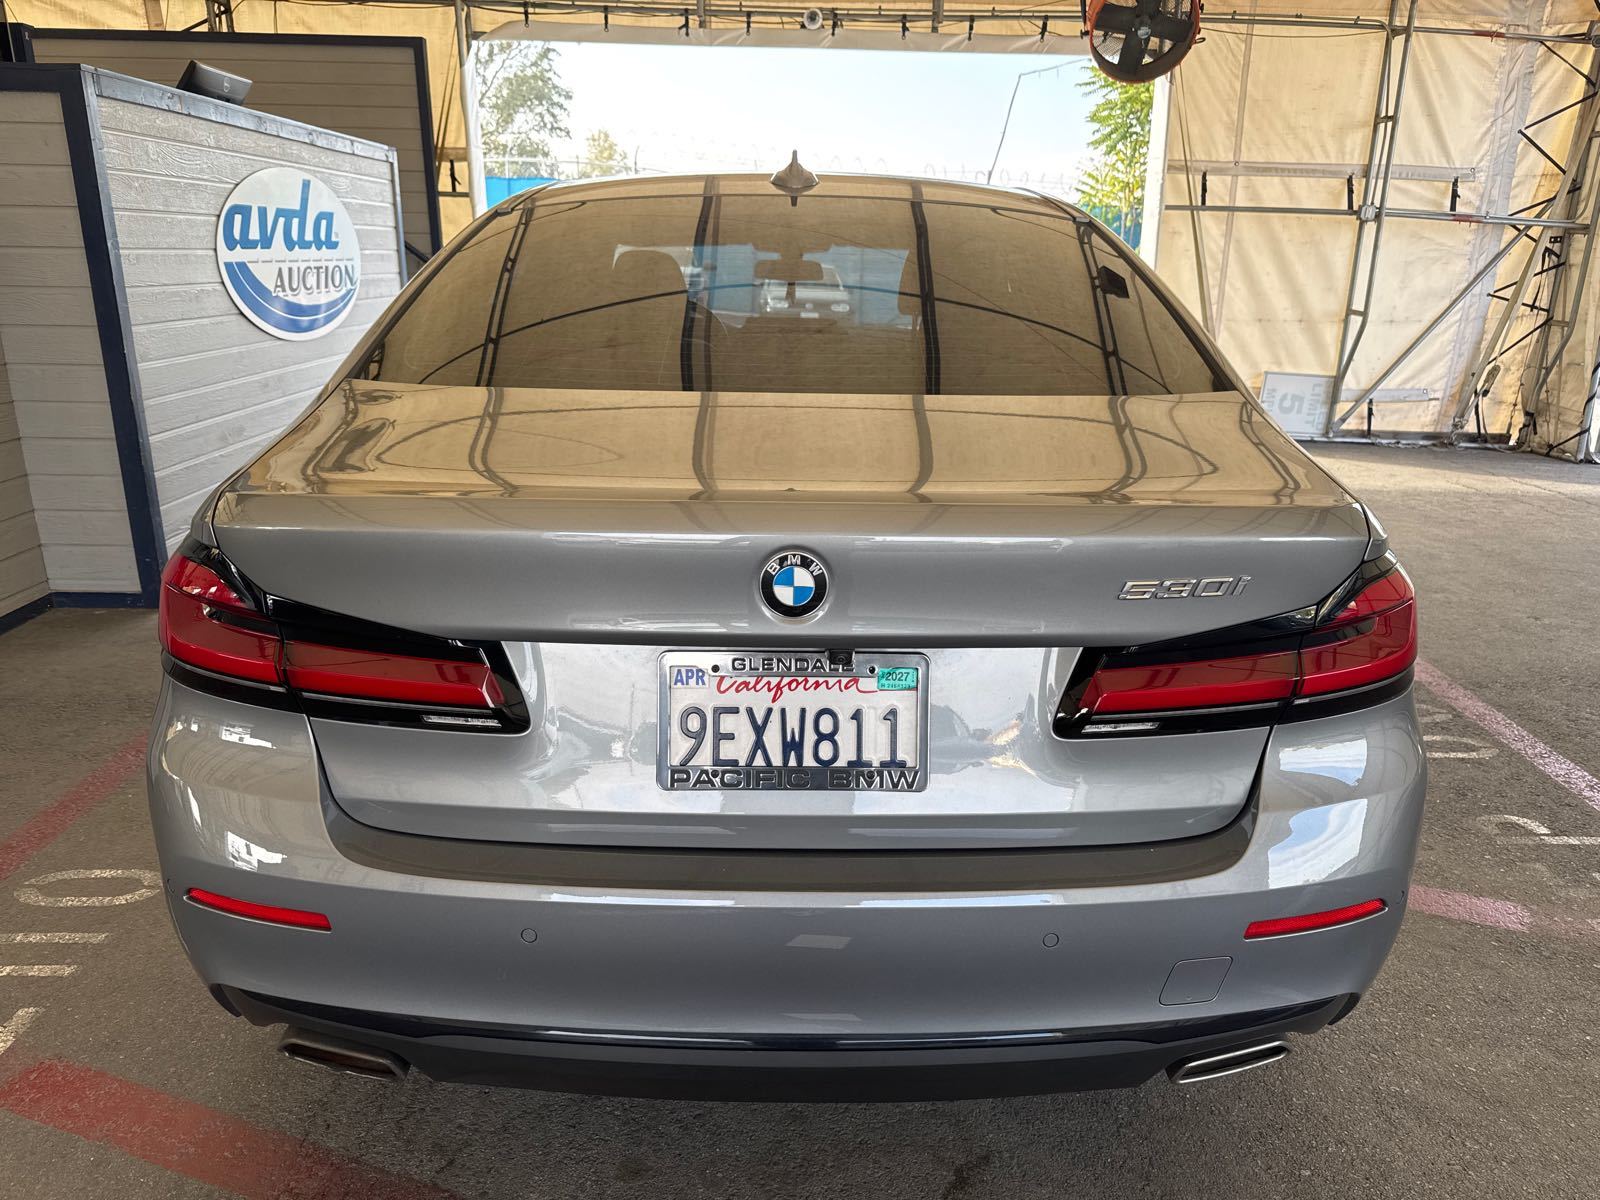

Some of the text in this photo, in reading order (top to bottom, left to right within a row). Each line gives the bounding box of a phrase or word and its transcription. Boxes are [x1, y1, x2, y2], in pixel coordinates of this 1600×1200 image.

[222, 179, 340, 252] avda
[273, 263, 359, 297] AUCTION
[1278, 392, 1306, 415] 5
[1304, 383, 1323, 428] LIMIT
[767, 554, 823, 576] BMW
[1118, 574, 1252, 600] 530i
[673, 668, 706, 686] APR
[716, 676, 878, 703] California
[885, 671, 910, 682] 2027
[679, 706, 908, 768] 9EXW811
[669, 769, 920, 790] PACIFIC BMW
